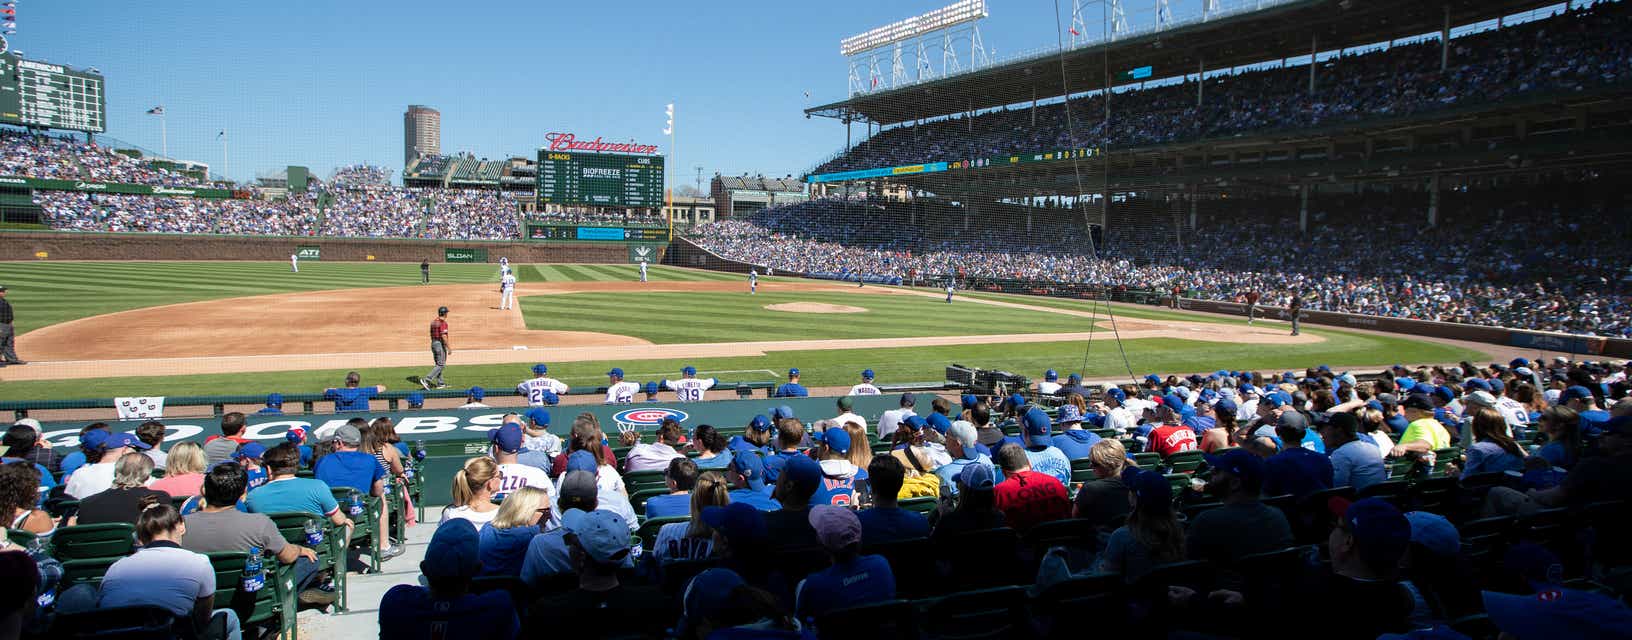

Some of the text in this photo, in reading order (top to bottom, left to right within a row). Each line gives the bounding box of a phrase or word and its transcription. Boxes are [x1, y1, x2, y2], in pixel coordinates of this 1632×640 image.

[18, 60, 64, 74] AMERICAN
[545, 132, 658, 154] Budweiser
[684, 388, 700, 402] 19
[239, 414, 526, 441] CBS
